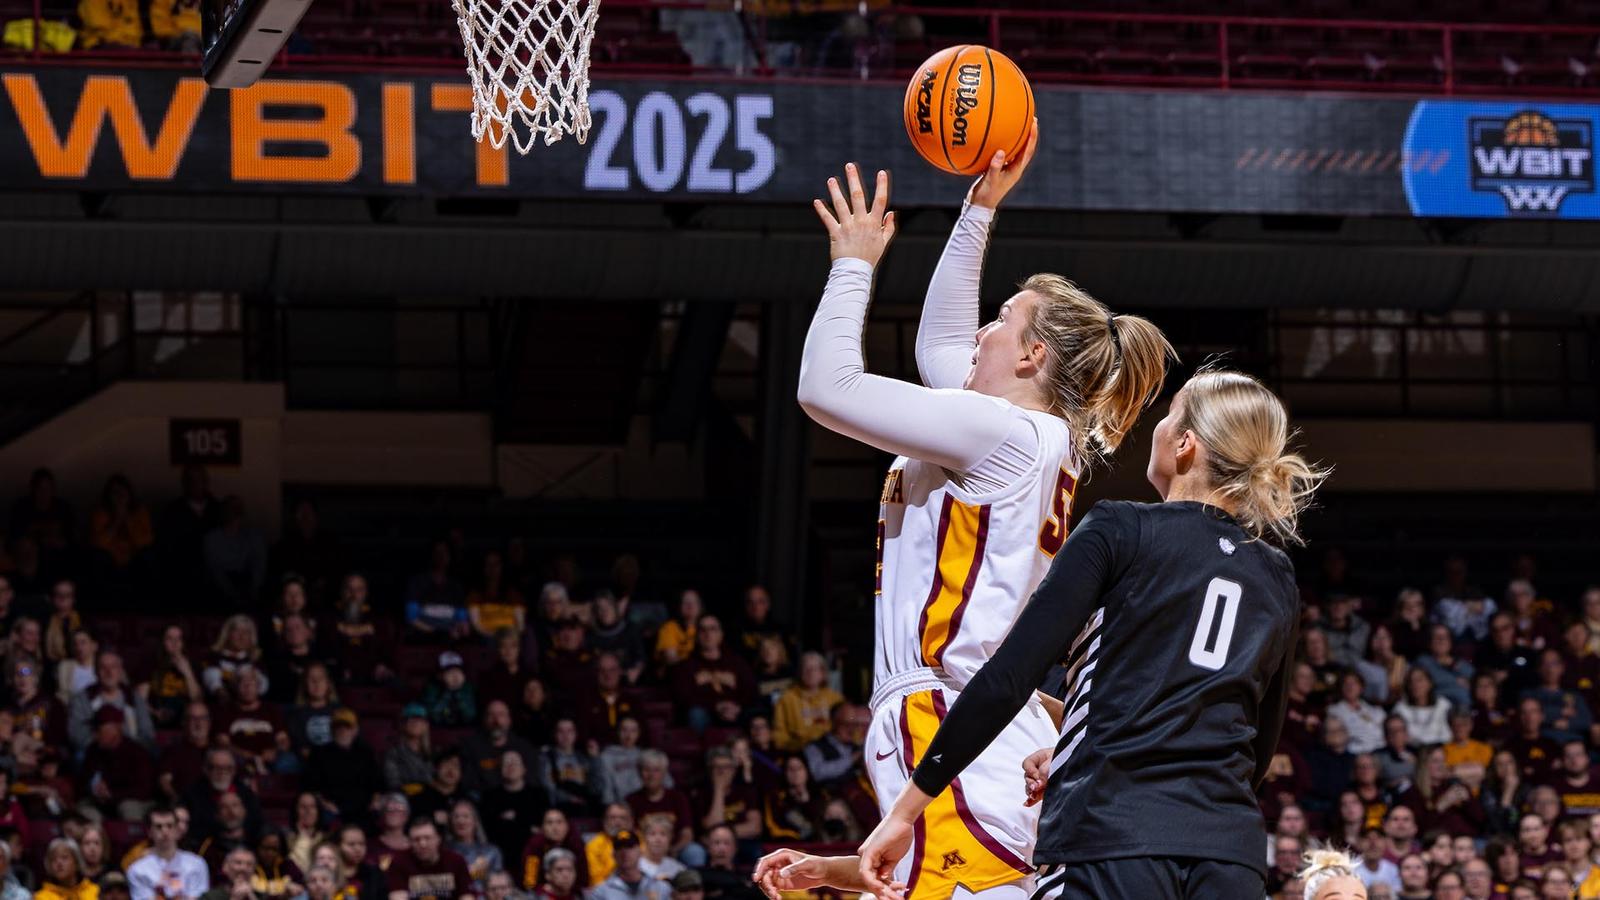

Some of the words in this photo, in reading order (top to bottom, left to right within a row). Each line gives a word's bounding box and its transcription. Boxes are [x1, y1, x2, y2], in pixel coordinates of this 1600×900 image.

[2, 74, 540, 186] WBIT
[584, 90, 777, 194] 2025
[952, 63, 982, 149] Wilson
[1473, 146, 1591, 177] WBIT
[180, 428, 229, 457] 105
[1188, 576, 1243, 672] 0
